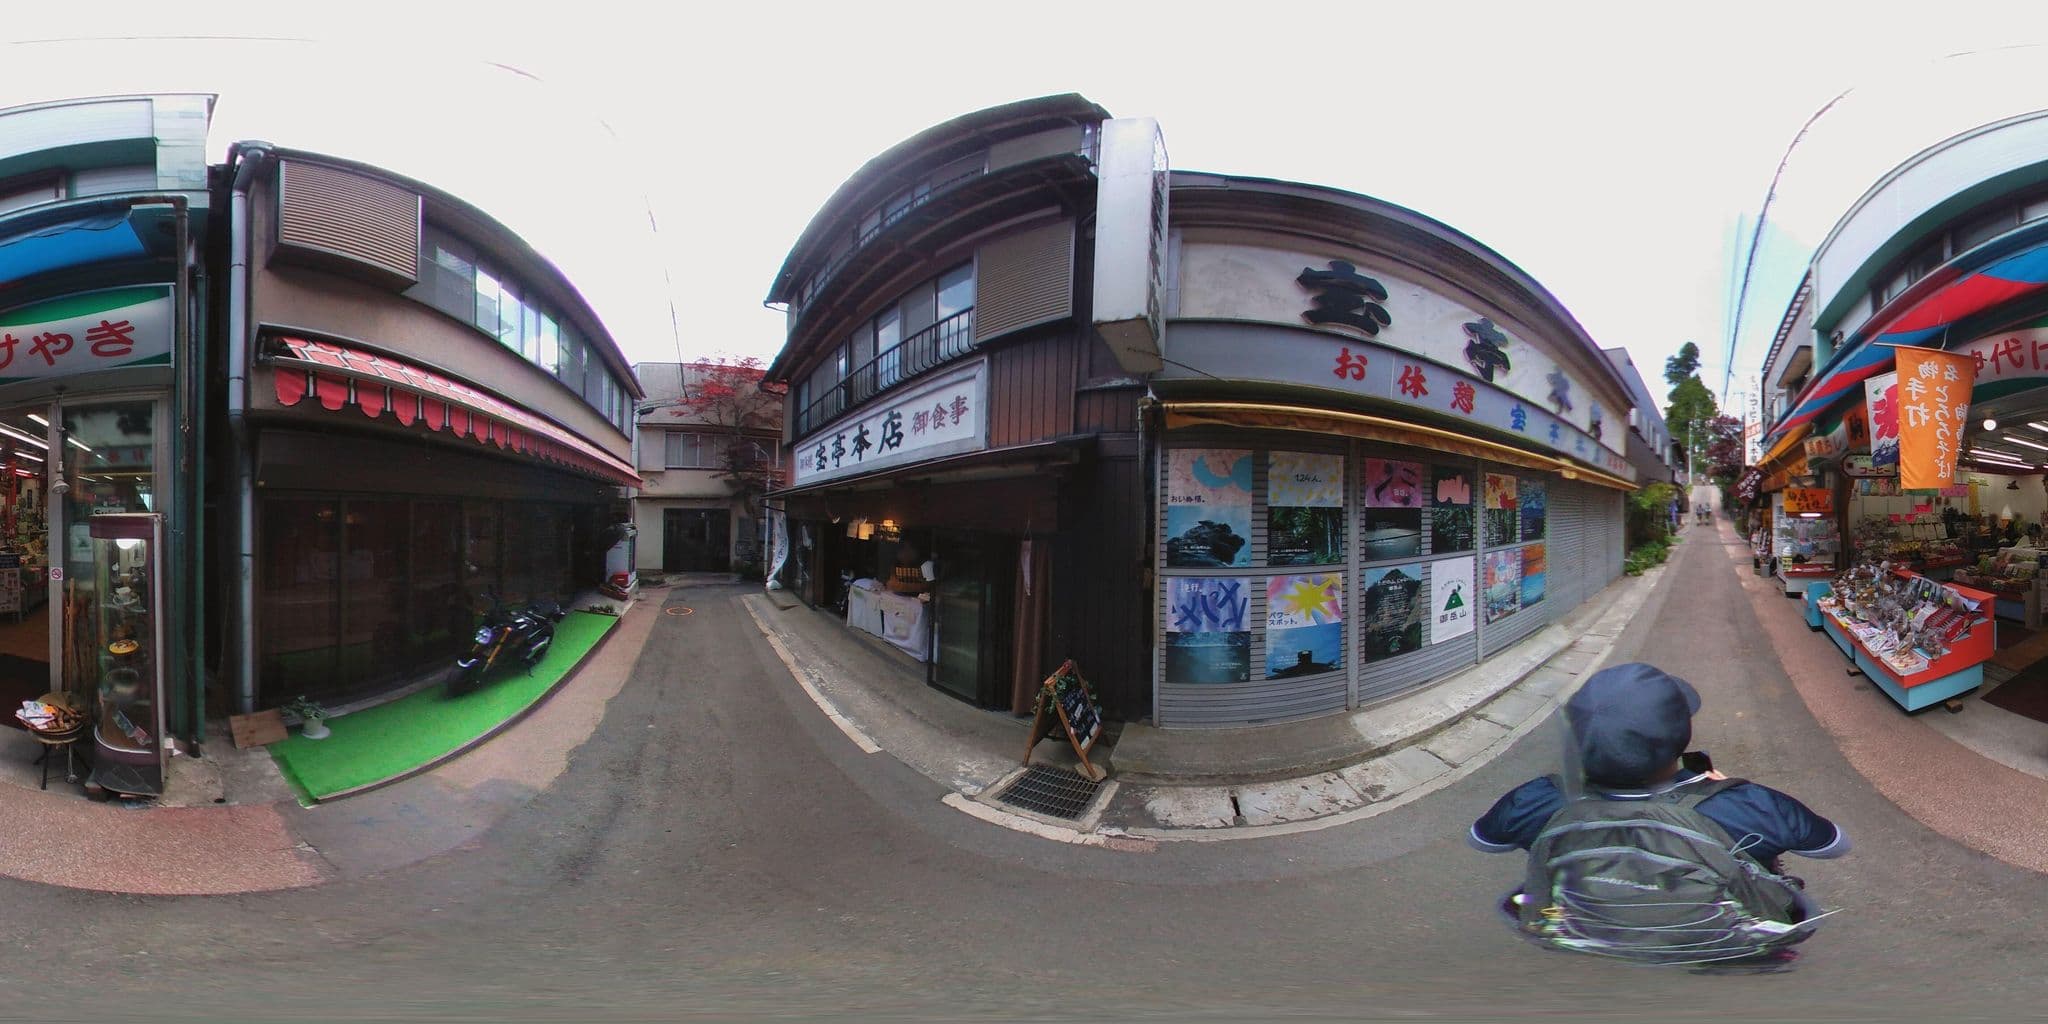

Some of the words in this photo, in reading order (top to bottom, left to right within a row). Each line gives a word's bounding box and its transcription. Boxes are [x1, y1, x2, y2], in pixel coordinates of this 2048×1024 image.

[1334, 347, 1476, 415] お休憩
[815, 410, 904, 472] 宝亭本店
[912, 395, 970, 436] 御食事
